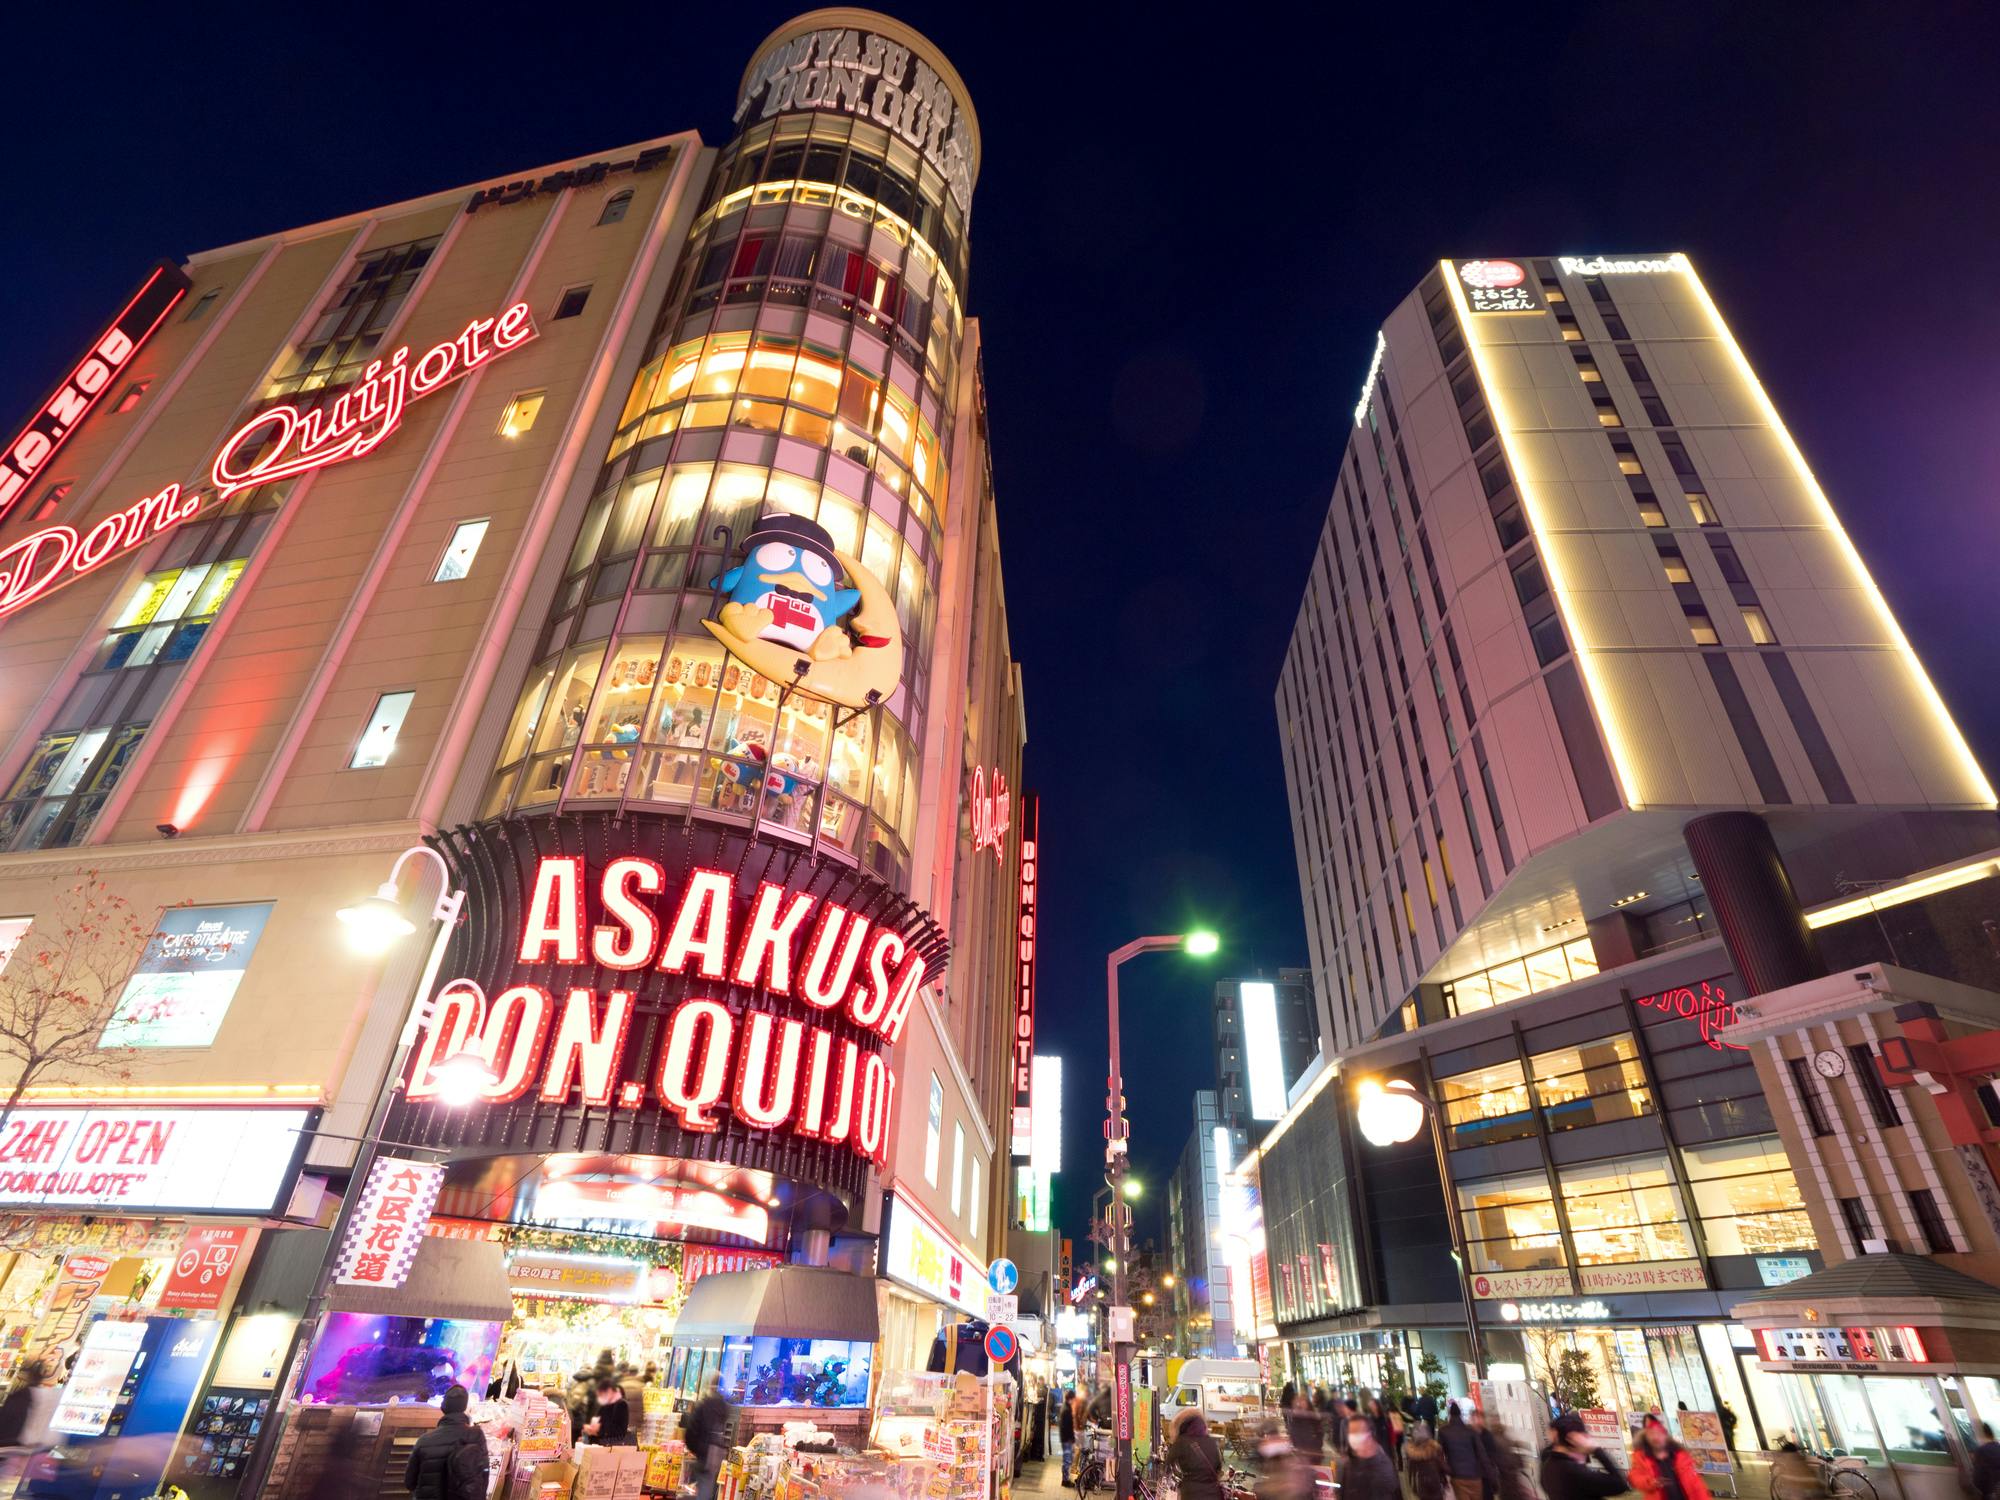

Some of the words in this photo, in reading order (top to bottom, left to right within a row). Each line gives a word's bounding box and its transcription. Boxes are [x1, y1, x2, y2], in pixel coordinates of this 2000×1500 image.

[1471, 287, 1529, 300] まるごと
[1475, 298, 1535, 311] にっぽん
[0, 483, 200, 618] Don.
[211, 301, 529, 500] Quijote
[518, 855, 927, 1047] ASAKUSA
[1017, 840, 1036, 1092] DON.QUIJOTE
[0, 1120, 70, 1164] 24H
[75, 1120, 177, 1165] OPEN
[351, 1167, 422, 1282] 六区花道
[1476, 1279, 1490, 1292] 4F
[989, 1313, 996, 1321] 10
[1005, 1313, 1014, 1321] 22
[1583, 1413, 1598, 1421] TAX
[1597, 1414, 1616, 1422] FREE
